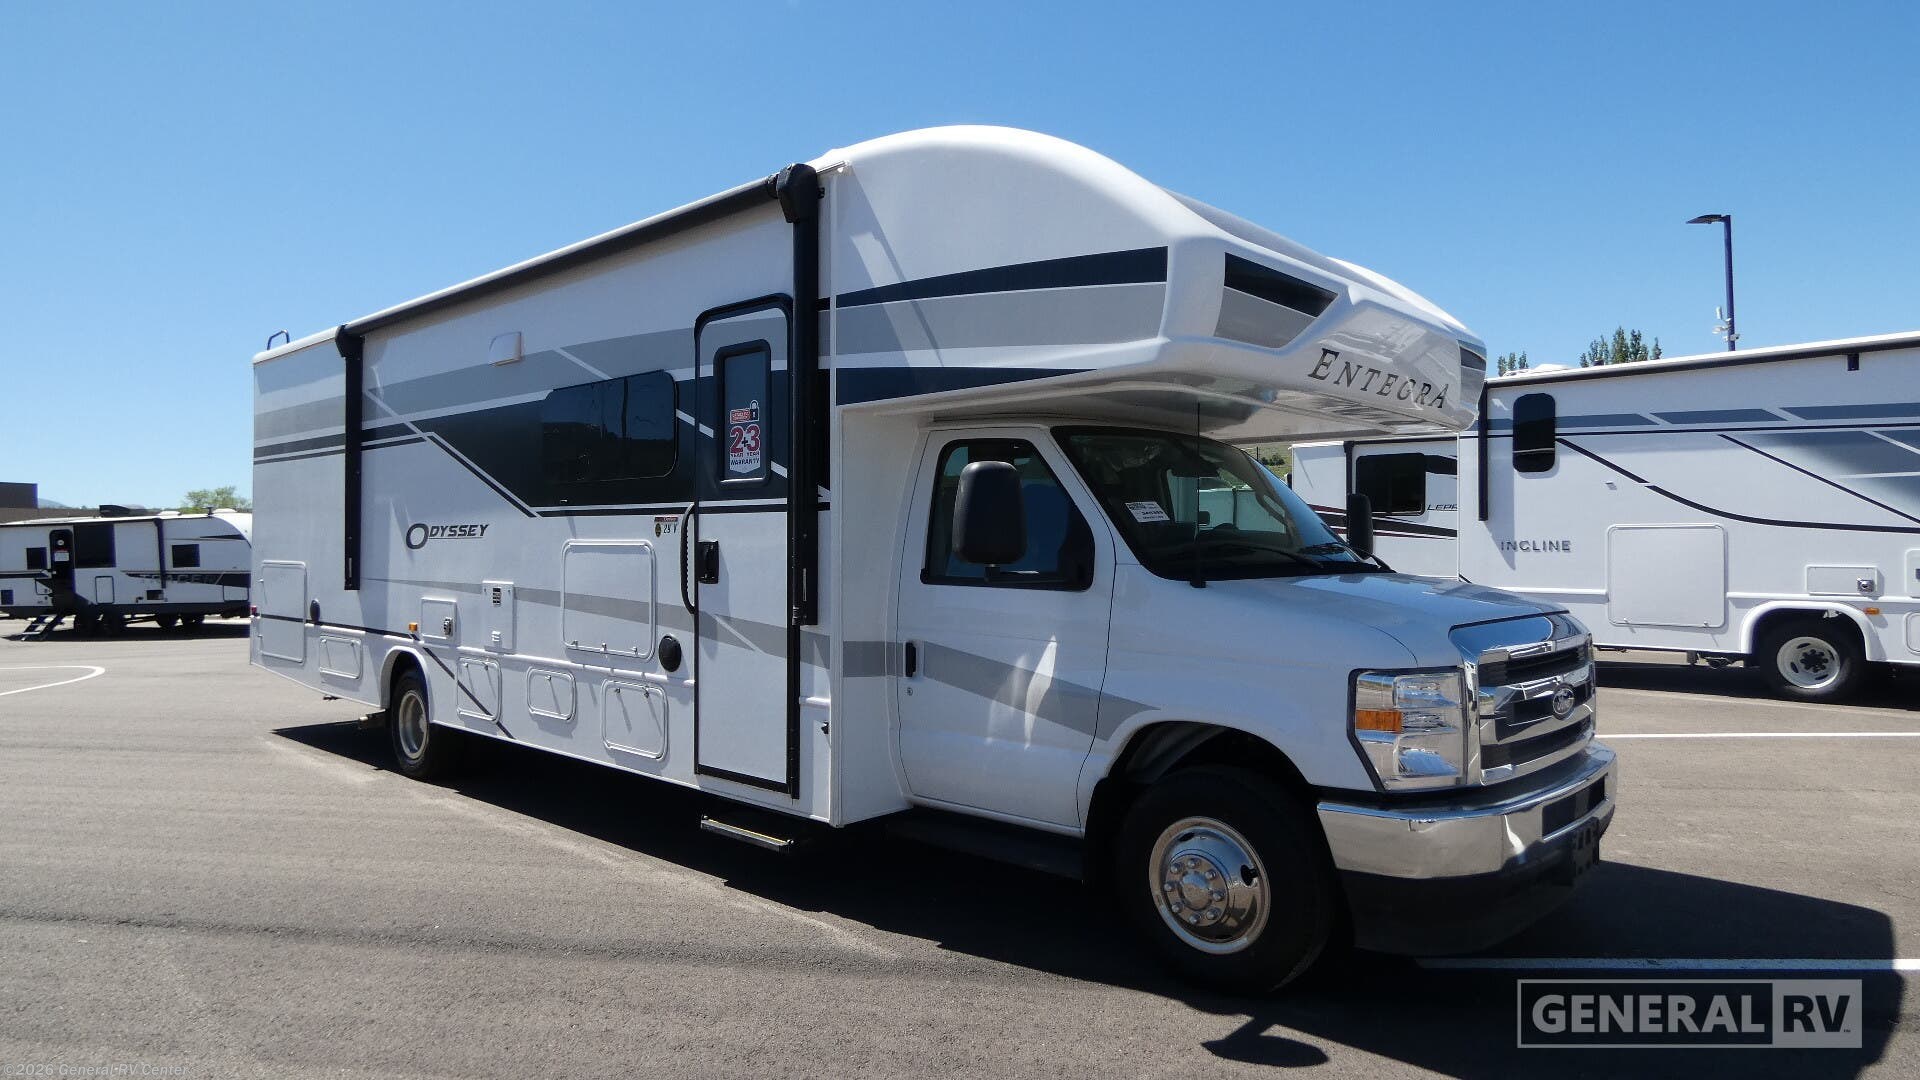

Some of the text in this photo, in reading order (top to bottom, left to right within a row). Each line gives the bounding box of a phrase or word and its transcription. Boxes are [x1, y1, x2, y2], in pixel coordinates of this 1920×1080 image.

[1308, 348, 1450, 409] ENTEGRA
[730, 458, 760, 466] WARRANTY
[405, 523, 490, 550] ODYSSEY
[1500, 540, 1572, 552] INCLINE
